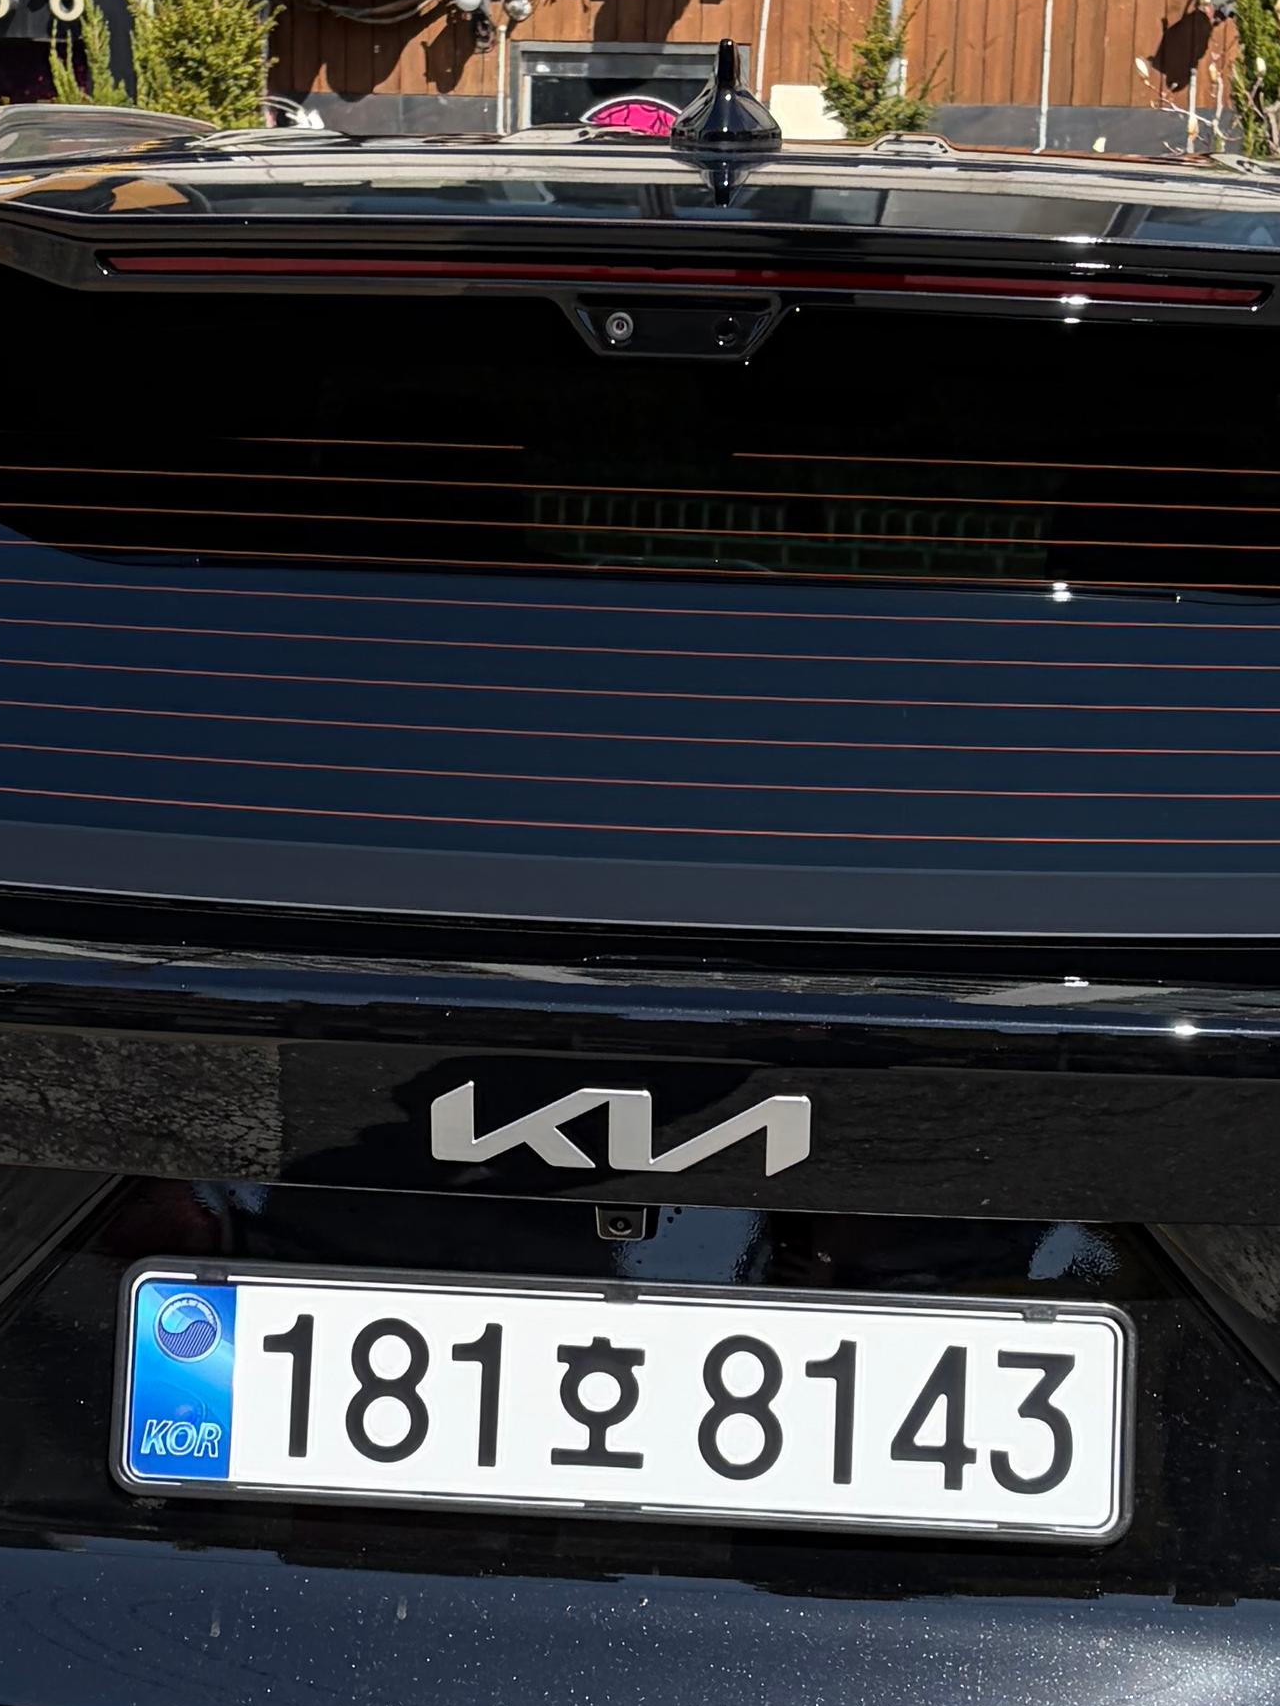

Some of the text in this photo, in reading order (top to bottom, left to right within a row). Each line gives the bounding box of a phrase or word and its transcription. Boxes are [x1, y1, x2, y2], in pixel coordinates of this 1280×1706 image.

[431, 1080, 812, 1177] KIA
[140, 1419, 222, 1458] KOR
[262, 1313, 1077, 1495] 181호 8143
